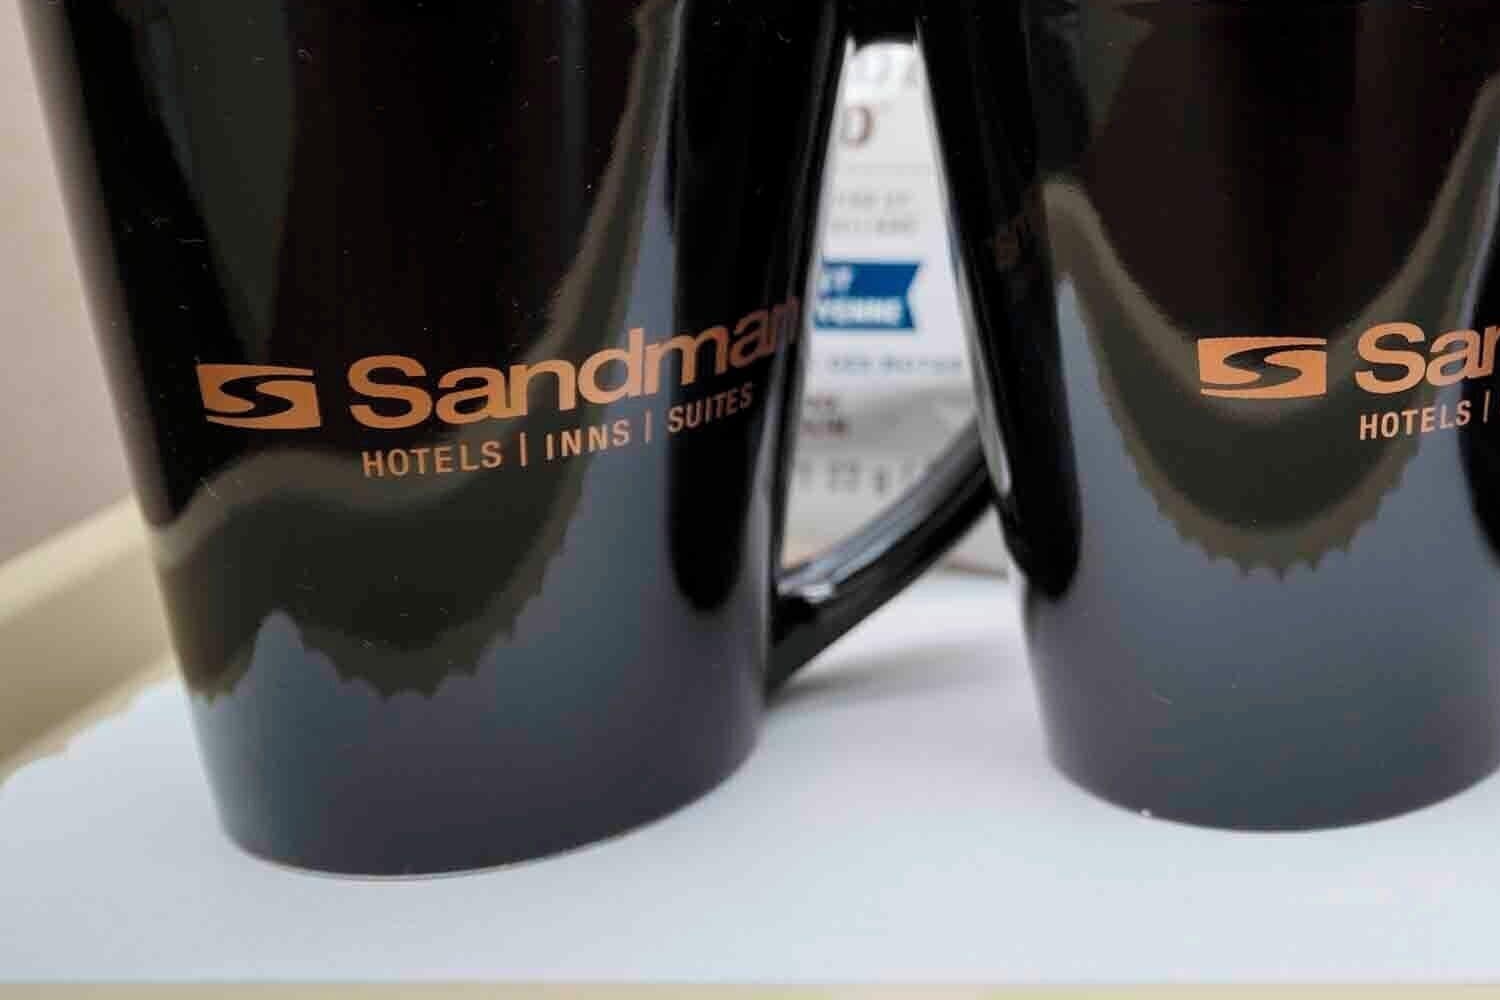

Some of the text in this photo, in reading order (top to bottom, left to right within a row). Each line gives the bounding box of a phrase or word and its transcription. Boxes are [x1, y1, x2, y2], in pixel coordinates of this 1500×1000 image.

[361, 439, 503, 478] HOTELS
[545, 419, 633, 461] INNS
[666, 382, 753, 434] SUITES
[1359, 399, 1472, 440] HOTELS
